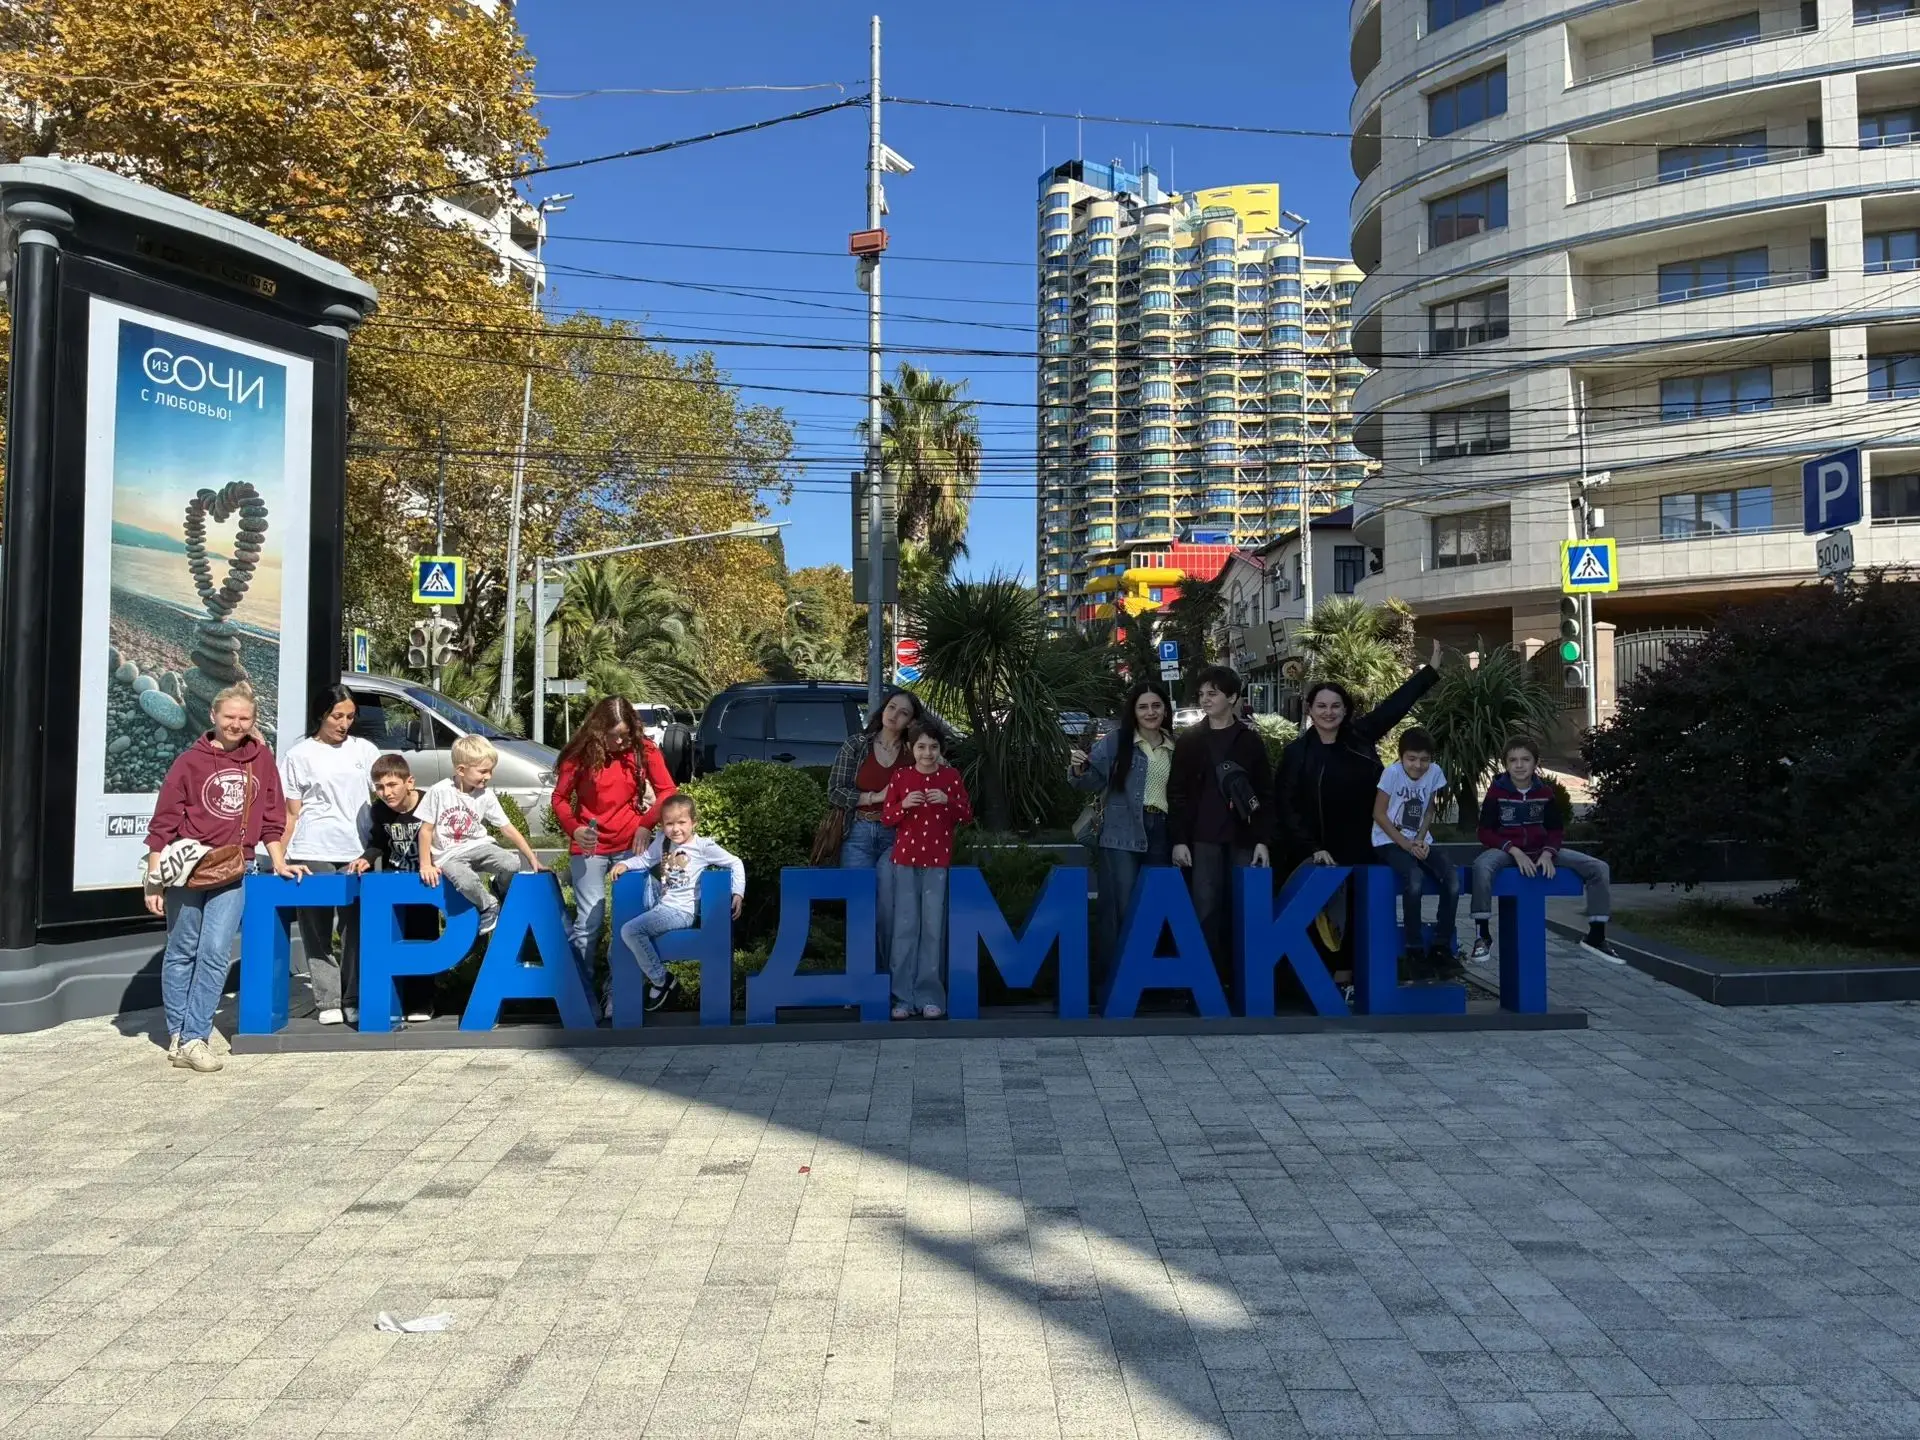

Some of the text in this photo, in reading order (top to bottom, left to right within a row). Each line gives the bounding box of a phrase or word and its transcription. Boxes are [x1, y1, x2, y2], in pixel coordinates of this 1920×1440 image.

[141, 388, 232, 422] С ЛЮБОВЬЮ!
[142, 347, 264, 409] СОЧИ
[1818, 461, 1849, 524] P
[1163, 643, 1175, 658] P
[240, 867, 891, 1034] ГРАНД
